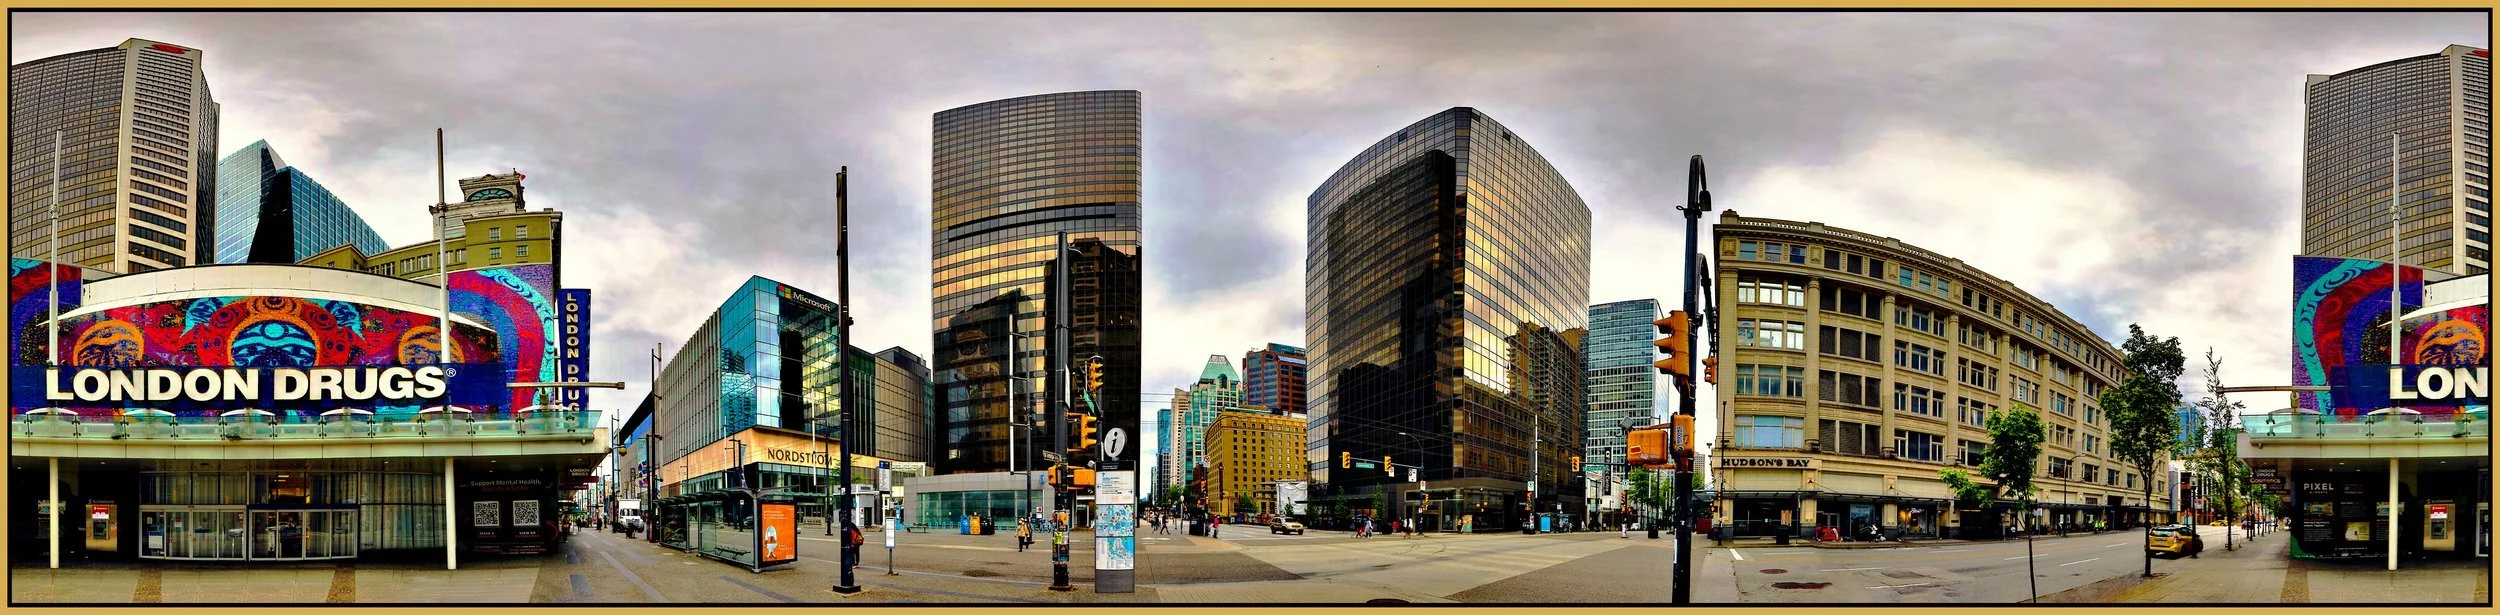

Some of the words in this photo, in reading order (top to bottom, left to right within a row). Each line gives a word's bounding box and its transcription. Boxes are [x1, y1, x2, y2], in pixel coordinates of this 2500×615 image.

[793, 291, 831, 312] Microsoft
[566, 293, 579, 358] LONDON
[46, 368, 259, 401] LONDON
[2390, 366, 2488, 400] LON
[1723, 458, 1783, 467] HUDSON'S
[1786, 459, 1810, 468] BAY
